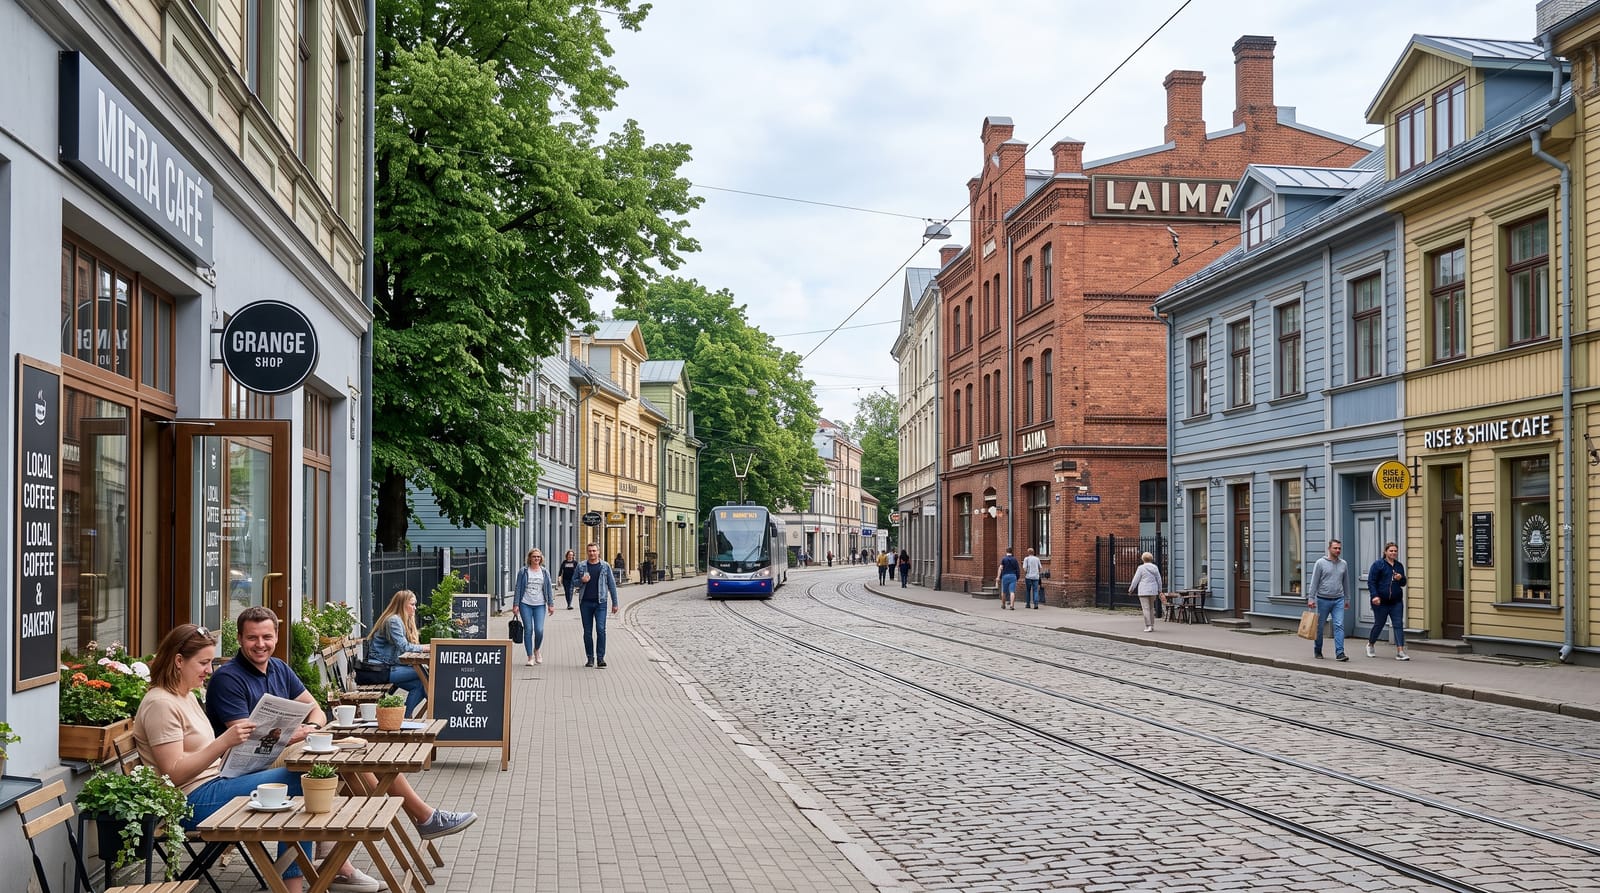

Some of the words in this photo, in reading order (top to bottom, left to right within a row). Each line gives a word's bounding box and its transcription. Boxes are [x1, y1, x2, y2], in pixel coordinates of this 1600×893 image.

[98, 87, 161, 212] MIERA
[165, 156, 204, 248] CAFÉ
[1106, 180, 1234, 213] LAIMA
[232, 330, 306, 354] GRANGE
[255, 356, 284, 368] SHOP
[1022, 429, 1048, 452] LAIMA
[1424, 428, 1452, 449] RISE
[1454, 426, 1465, 446] &
[1466, 420, 1509, 444] SHINE
[1511, 414, 1551, 438] CAFE
[26, 450, 54, 479] LOCAL
[23, 482, 56, 510] COFFEE
[26, 521, 53, 547] LOCAL
[23, 551, 55, 577] COFFEE
[35, 582, 43, 606] &
[22, 610, 55, 639] BAKERY
[440, 651, 473, 664] MIERA
[475, 649, 501, 665] CAFÉ
[455, 676, 485, 688] LOCAL
[452, 690, 488, 702] COFFEE
[465, 703, 473, 715] &
[449, 716, 488, 728] BAKERY
